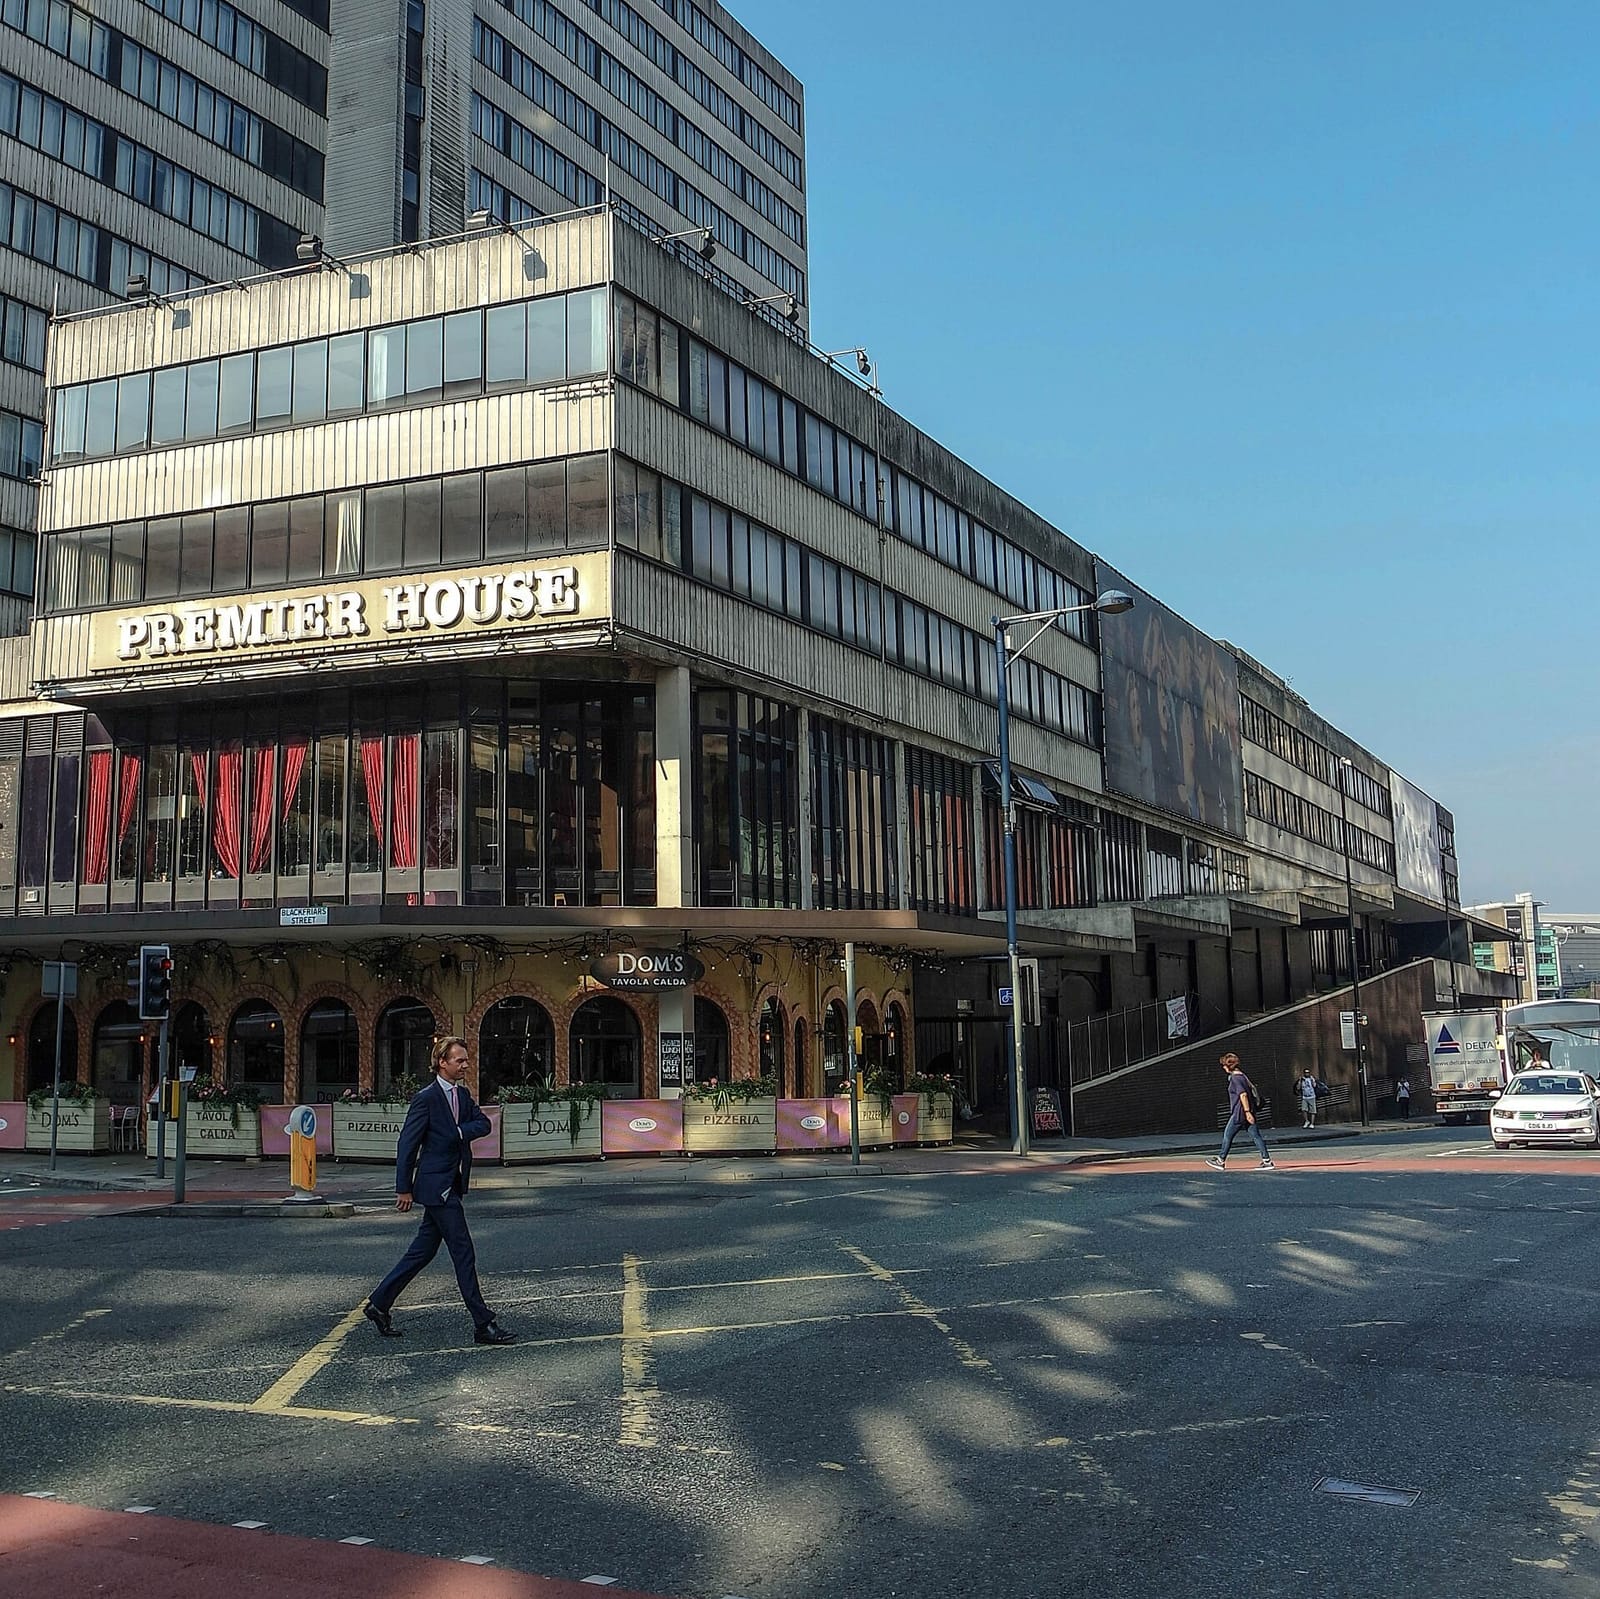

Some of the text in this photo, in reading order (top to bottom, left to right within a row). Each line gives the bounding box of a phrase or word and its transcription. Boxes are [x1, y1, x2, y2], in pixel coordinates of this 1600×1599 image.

[115, 565, 580, 661] PREMIER HOUSE
[280, 908, 327, 917] BLACKFRIARS
[616, 953, 684, 974] DOM'S
[611, 978, 687, 986] TAVOLA CALDA
[661, 1046, 681, 1054] LUNCH
[1465, 1041, 1495, 1050] DELTA
[703, 1115, 761, 1125] PIZZERIA
[1034, 1112, 1059, 1123] PIZZA
[347, 1122, 401, 1133] PIZZERIA
[200, 1128, 236, 1140] CALDA
